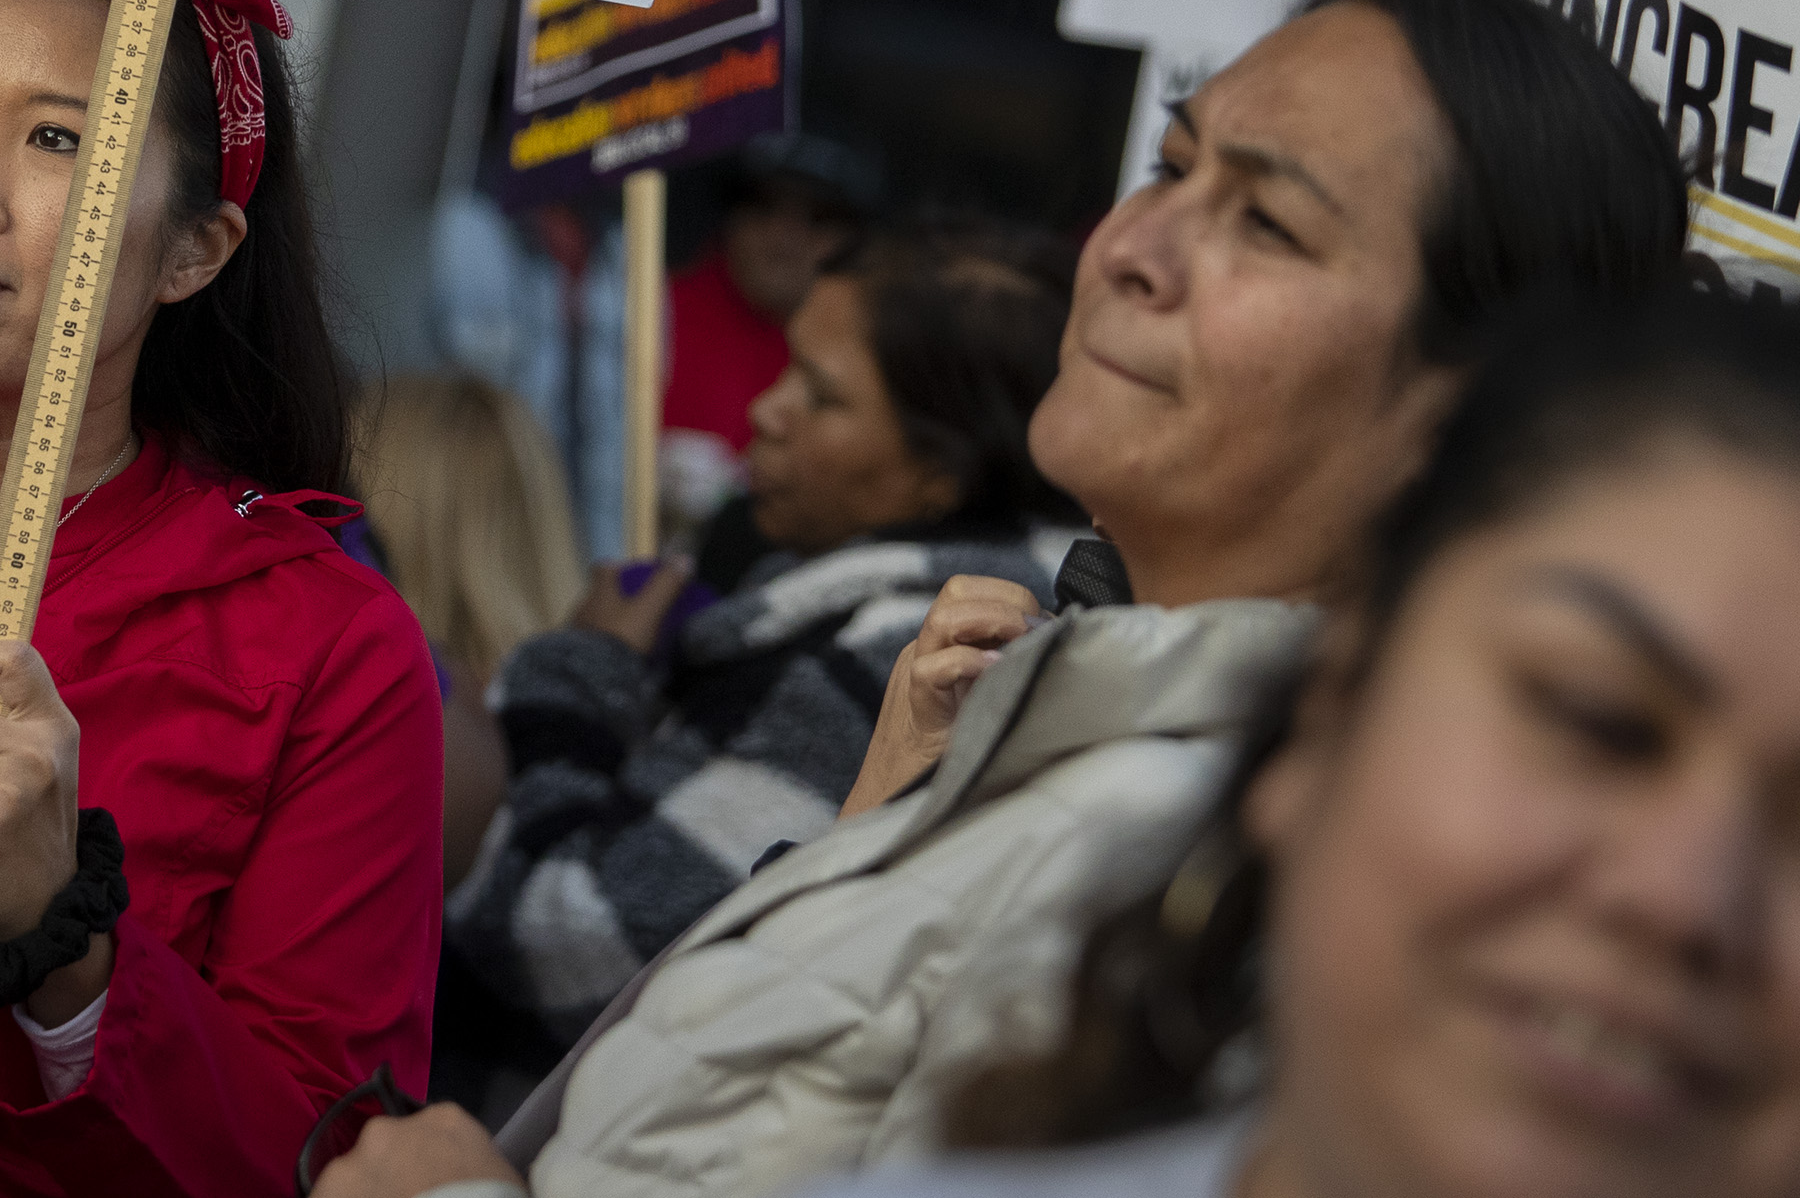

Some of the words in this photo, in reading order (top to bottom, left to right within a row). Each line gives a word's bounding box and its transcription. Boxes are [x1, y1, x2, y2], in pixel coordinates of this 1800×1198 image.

[131, 20, 143, 35] 37
[125, 43, 138, 58] 38
[120, 66, 133, 81] 39
[114, 88, 129, 105] 40
[110, 111, 122, 126] 41
[105, 134, 117, 150] 42
[99, 158, 112, 174] 43
[95, 181, 107, 196] 44
[89, 205, 101, 221] 45
[84, 227, 96, 243] 46
[79, 251, 91, 268] 47
[74, 273, 86, 289] 48
[69, 297, 81, 312] 49
[62, 320, 78, 338] 50
[59, 345, 72, 359] 51
[54, 368, 67, 383] 52
[49, 391, 61, 406] 53
[44, 414, 56, 429] 54
[38, 437, 51, 452] 55
[33, 460, 46, 475] 56
[28, 484, 40, 499] 57
[23, 507, 35, 522] 58
[18, 530, 30, 545] 59
[10, 552, 26, 569] 60
[7, 576, 19, 590] 61
[1, 600, 14, 614] 62
